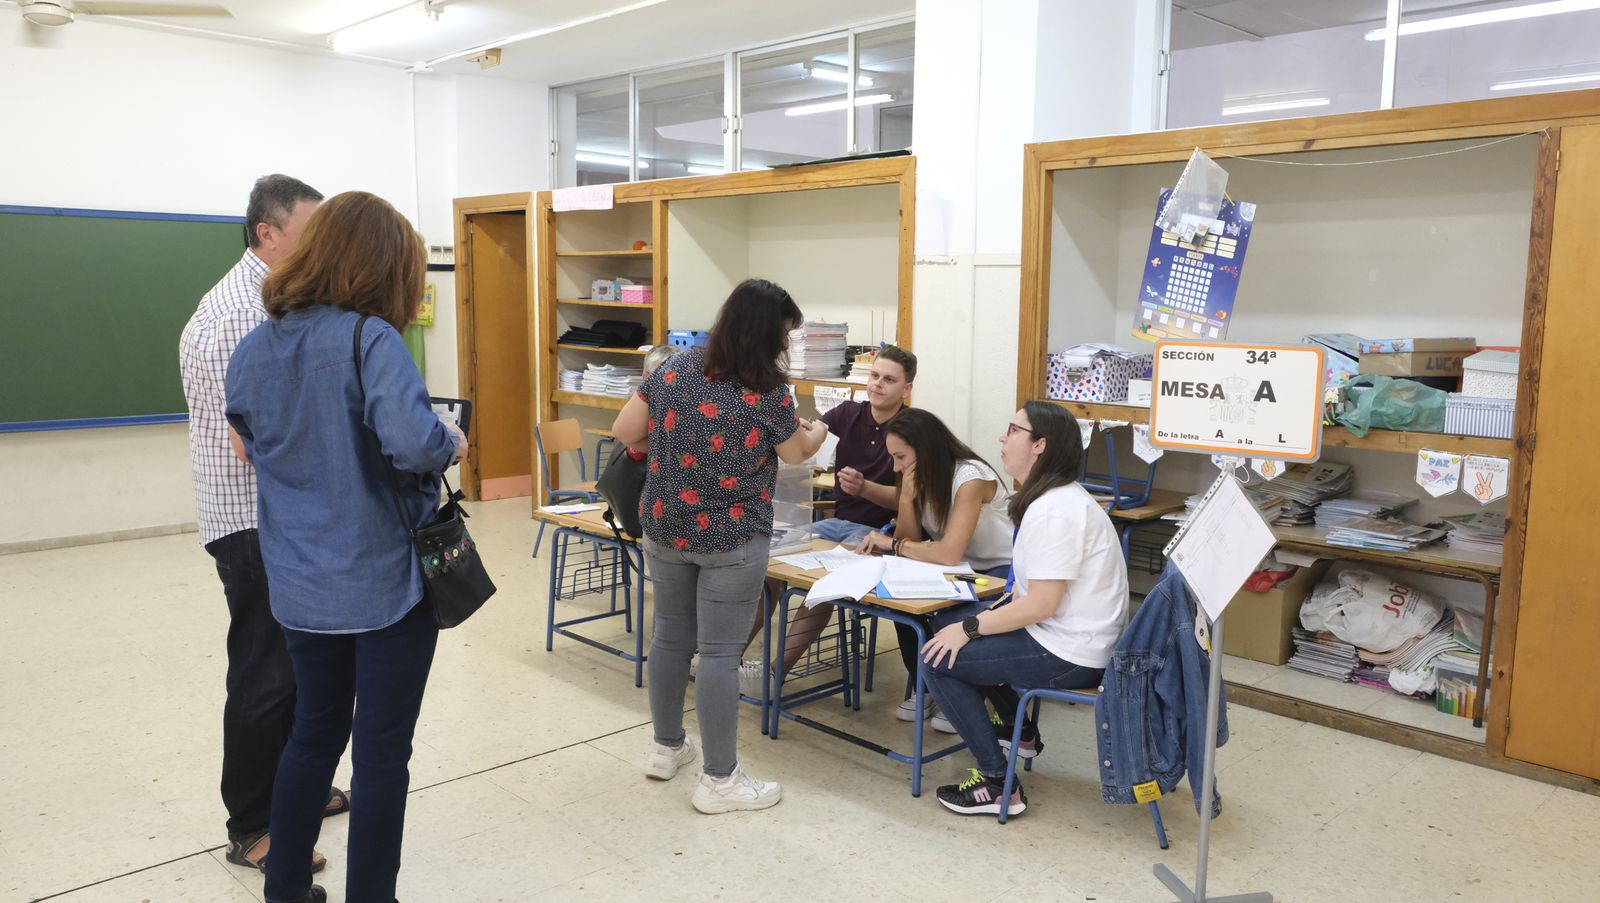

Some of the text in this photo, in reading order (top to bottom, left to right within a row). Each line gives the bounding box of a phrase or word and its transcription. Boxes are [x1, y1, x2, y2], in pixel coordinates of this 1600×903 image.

[1162, 350, 1215, 361] SECCIÓN
[1161, 381, 1277, 403] MESA A
[1158, 430, 1169, 438] De
[1171, 431, 1178, 439] la
[1180, 432, 1199, 441] letra
[1215, 429, 1224, 439] A
[1245, 437, 1253, 446] la
[1278, 434, 1286, 443] L
[1428, 457, 1450, 468] PAZ
